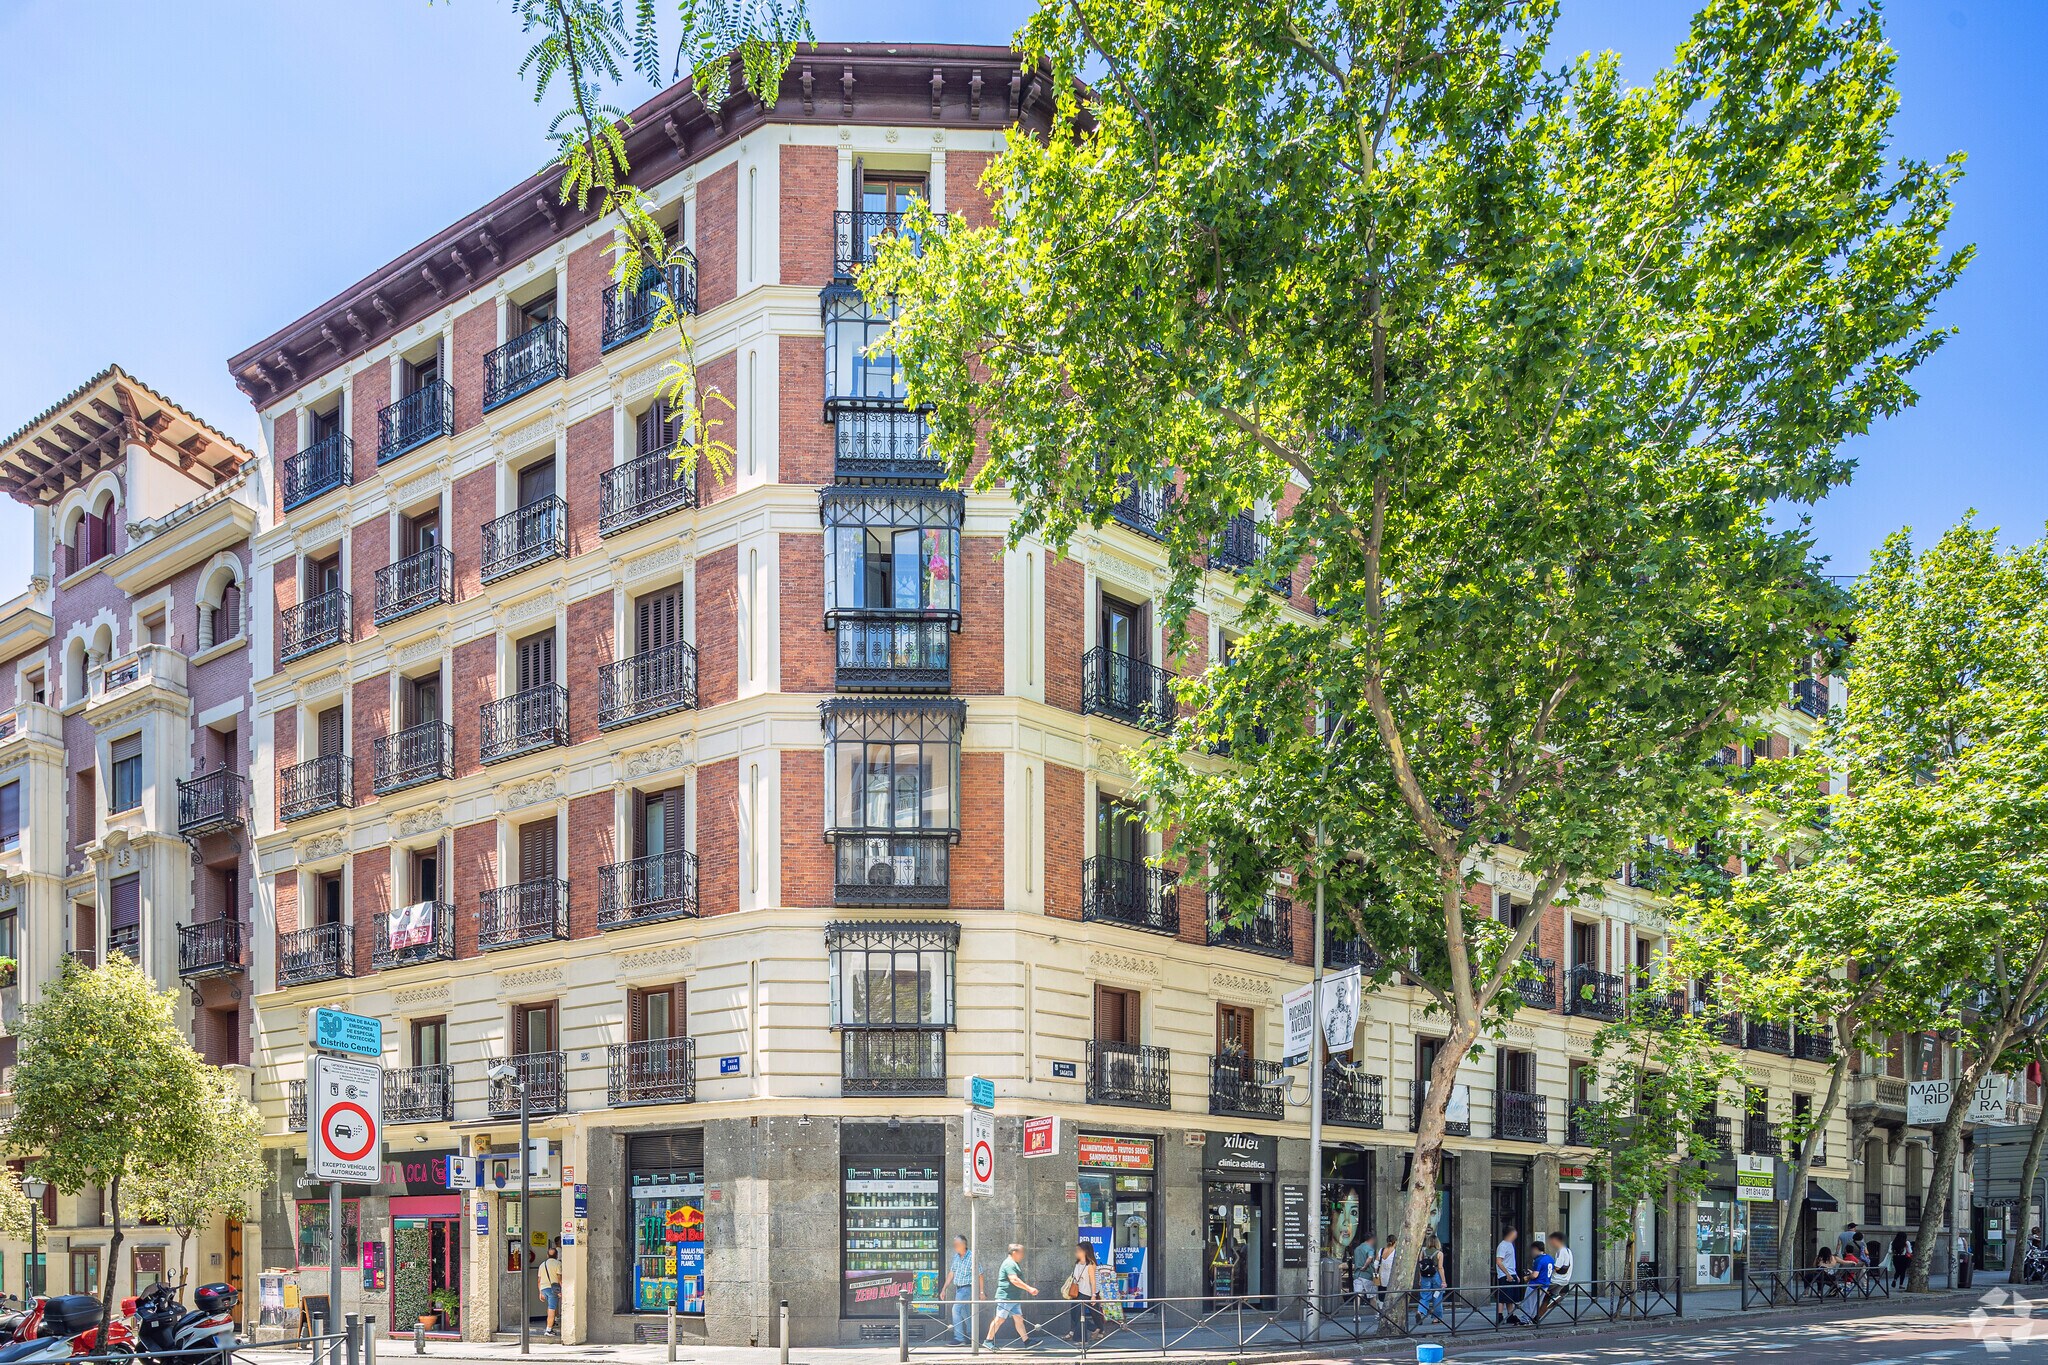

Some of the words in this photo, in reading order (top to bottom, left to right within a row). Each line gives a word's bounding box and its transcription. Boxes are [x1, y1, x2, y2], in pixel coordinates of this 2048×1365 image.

[1289, 1000, 1312, 1020] RICHARD
[1291, 1014, 1311, 1033] AVEDON
[347, 1034, 375, 1043] PROTECCIÓN
[321, 1038, 348, 1048] Distrito
[351, 1043, 377, 1053] Centro
[1911, 1083, 1949, 1095] MAD
[1978, 1079, 1997, 1089] UL
[1924, 1094, 1949, 1104] RID
[1980, 1100, 2002, 1111] RA
[1081, 1144, 1113, 1152] ALIMENTACIÓN
[1218, 1159, 1240, 1167] clínica
[1240, 1160, 1265, 1168] estética
[297, 1177, 320, 1188] Corona
[1740, 1177, 1772, 1187] DISPONIBLE
[666, 1227, 686, 1242] Red
[688, 1226, 704, 1241] Bul
[855, 1287, 878, 1302] ZERO
[879, 1281, 913, 1298] AZÚCAR
